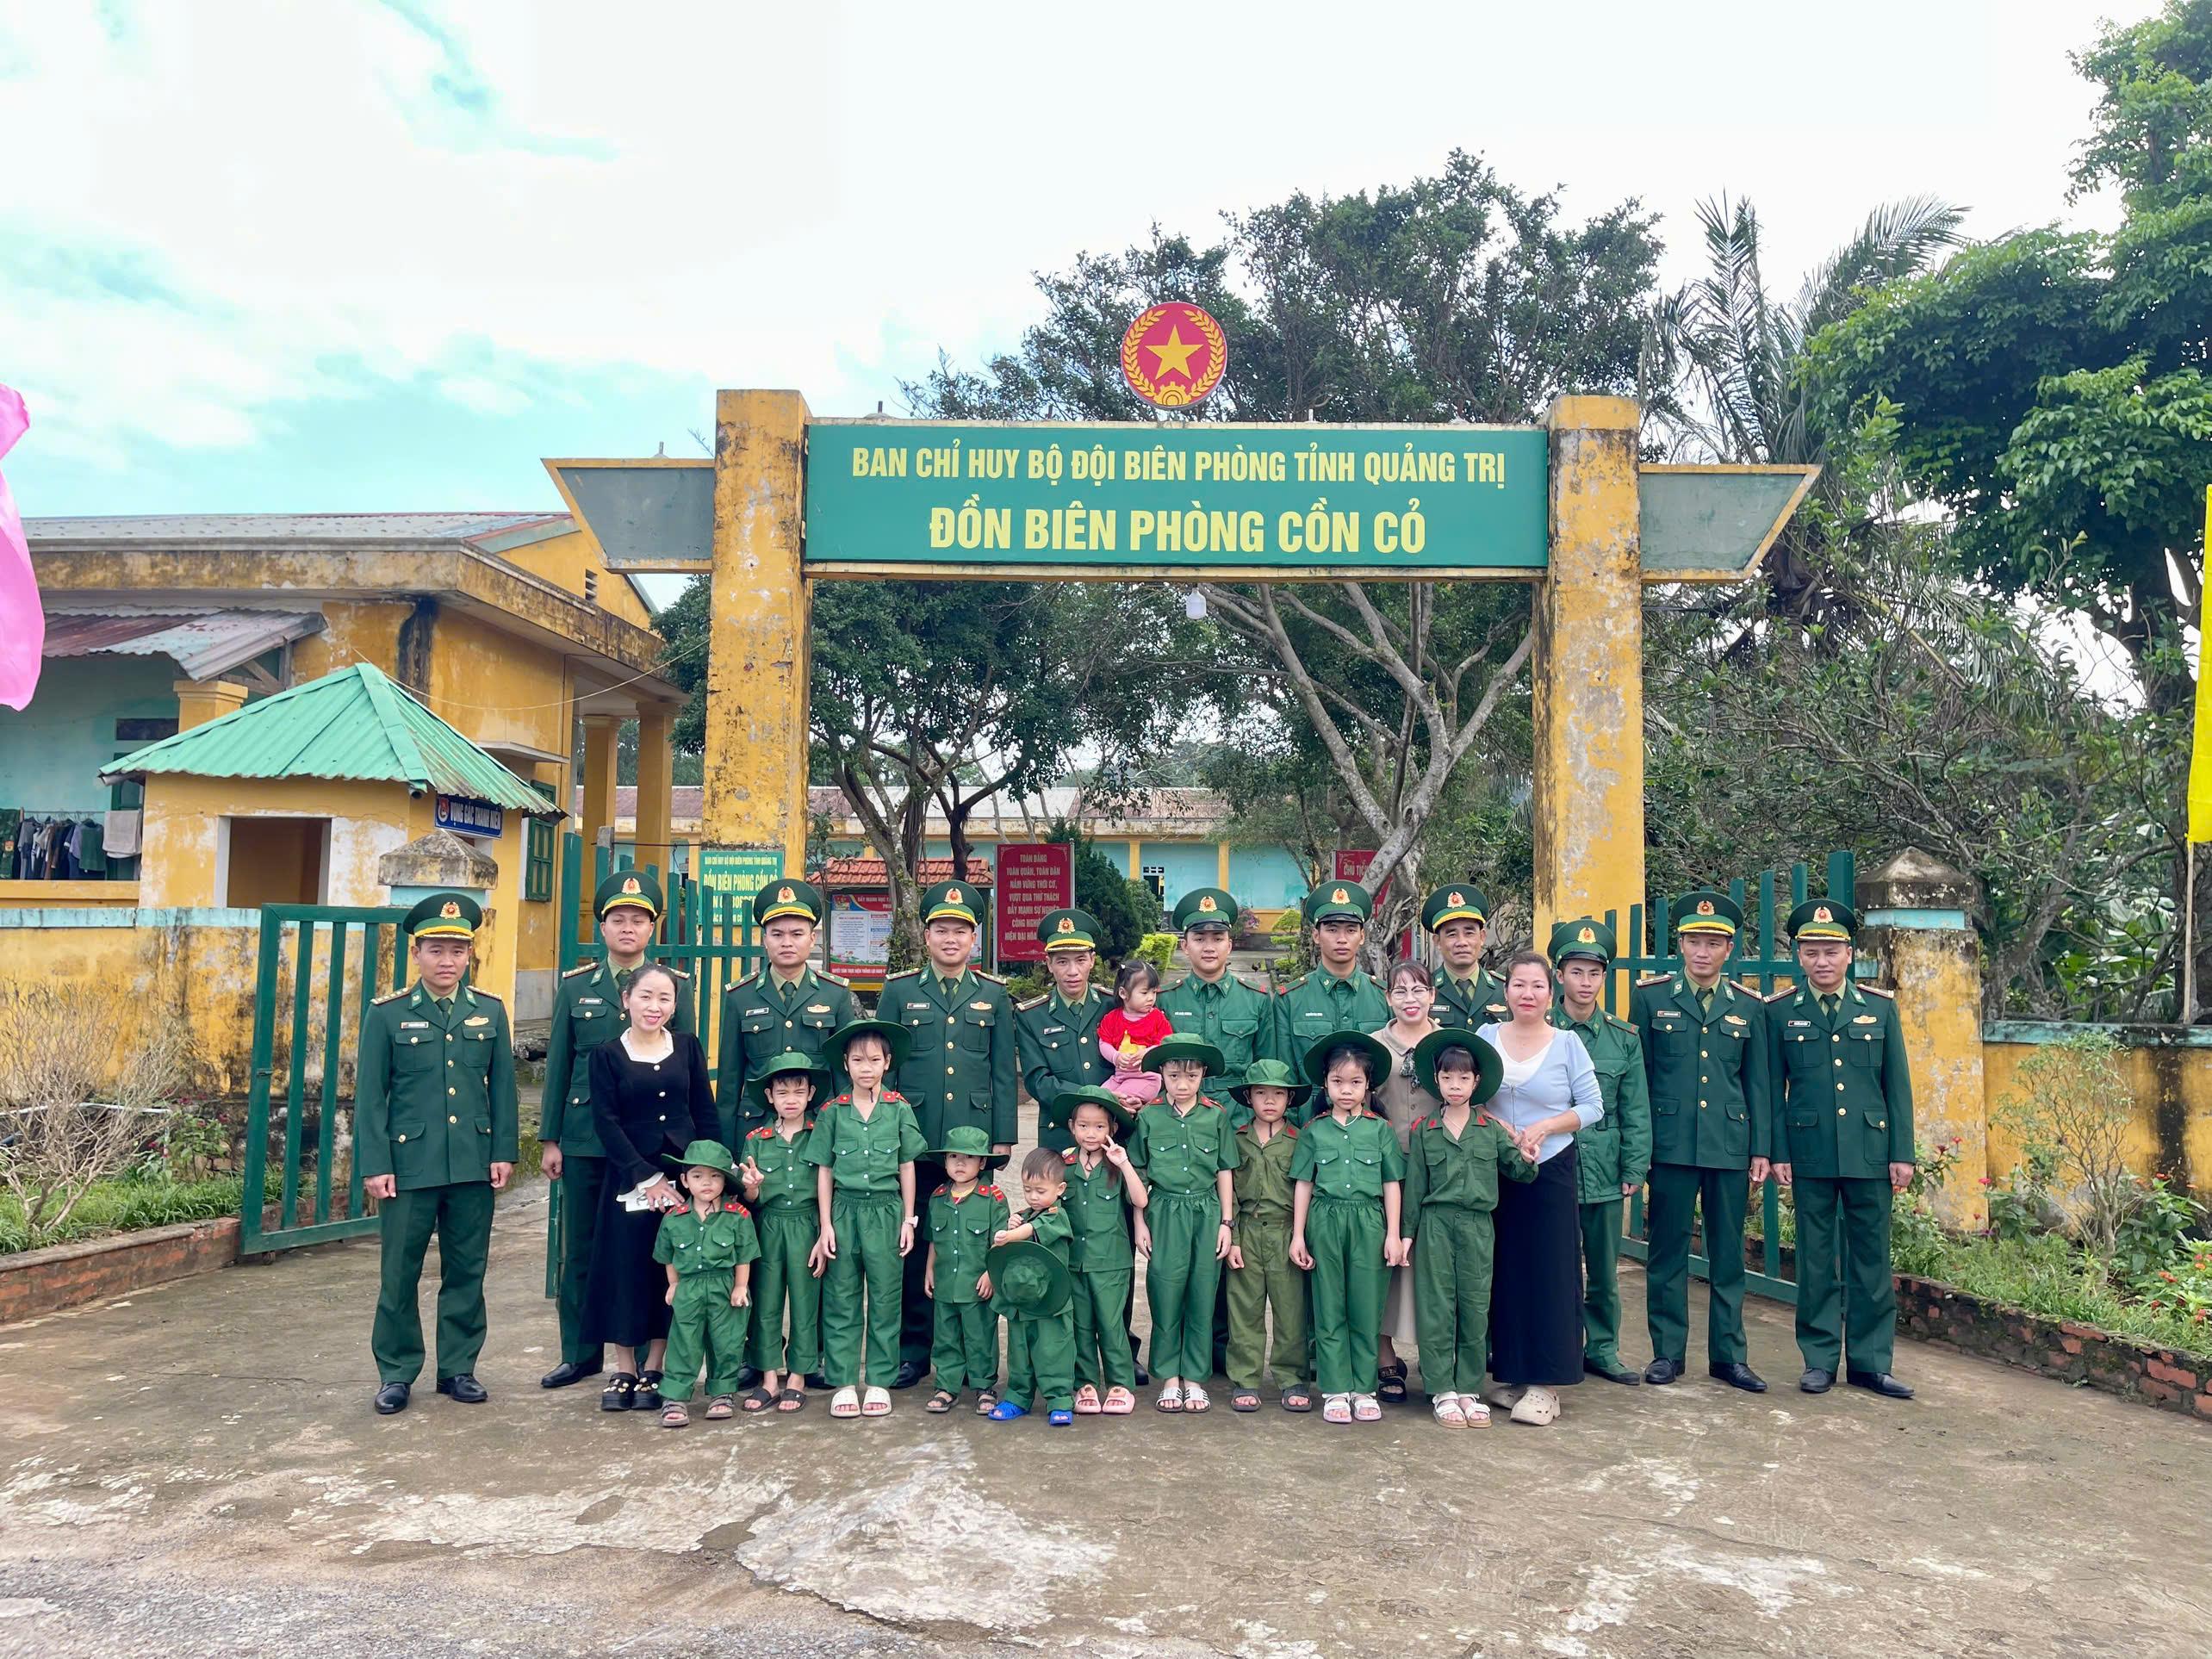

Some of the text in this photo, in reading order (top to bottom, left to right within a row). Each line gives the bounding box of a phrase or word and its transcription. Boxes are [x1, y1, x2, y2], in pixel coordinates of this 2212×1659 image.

[853, 438, 1506, 489] BAN CHỈ HUY BỘ ĐỘI BIÊN PHÒNG TỈNH QUẢNG TRỊ
[929, 494, 1426, 554] ĐỒN BIÊN PHÒNG CỒN CỎ
[718, 871, 732, 891] BIÊN
[733, 870, 755, 891] PHÒNG
